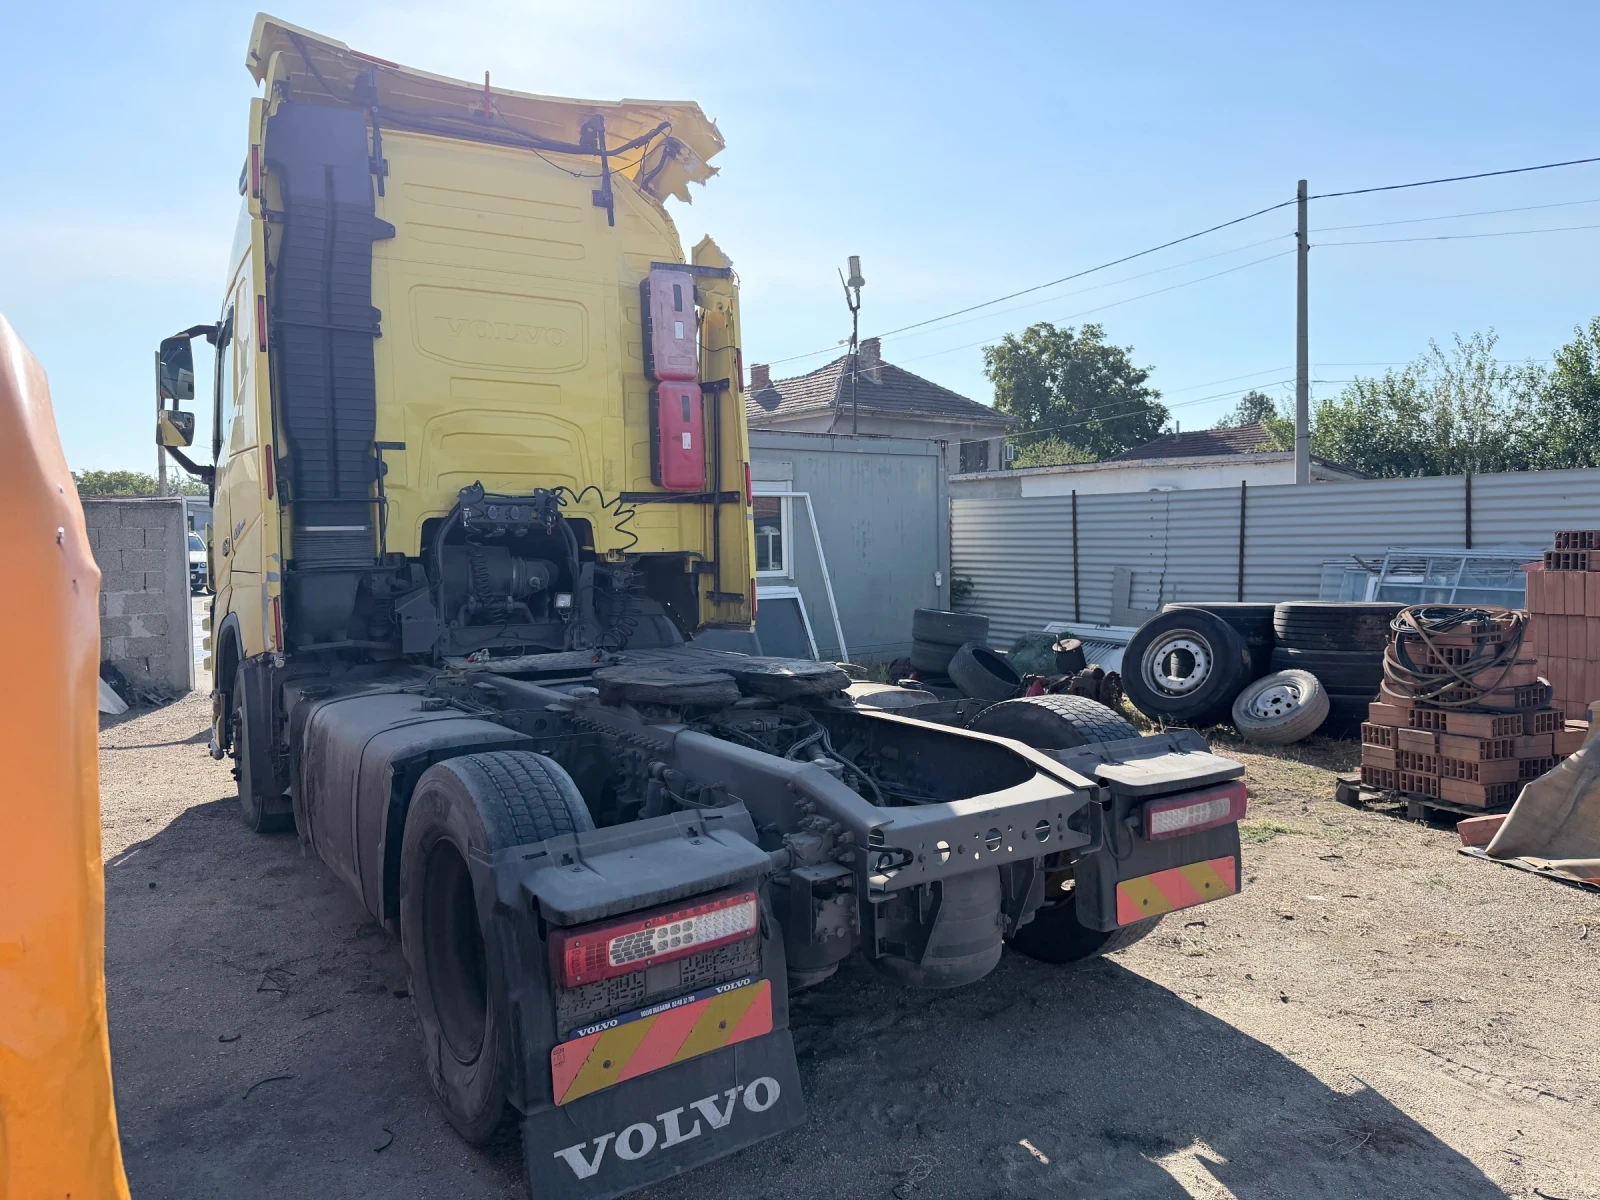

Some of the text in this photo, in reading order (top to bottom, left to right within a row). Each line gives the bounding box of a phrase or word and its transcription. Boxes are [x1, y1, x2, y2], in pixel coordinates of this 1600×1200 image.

[434, 316, 568, 347] VOLVO
[715, 978, 750, 993] VOLVO
[640, 1008, 652, 1018] VOLVO
[577, 1019, 618, 1037] VOLVO
[553, 1076, 781, 1180] VOLVO
